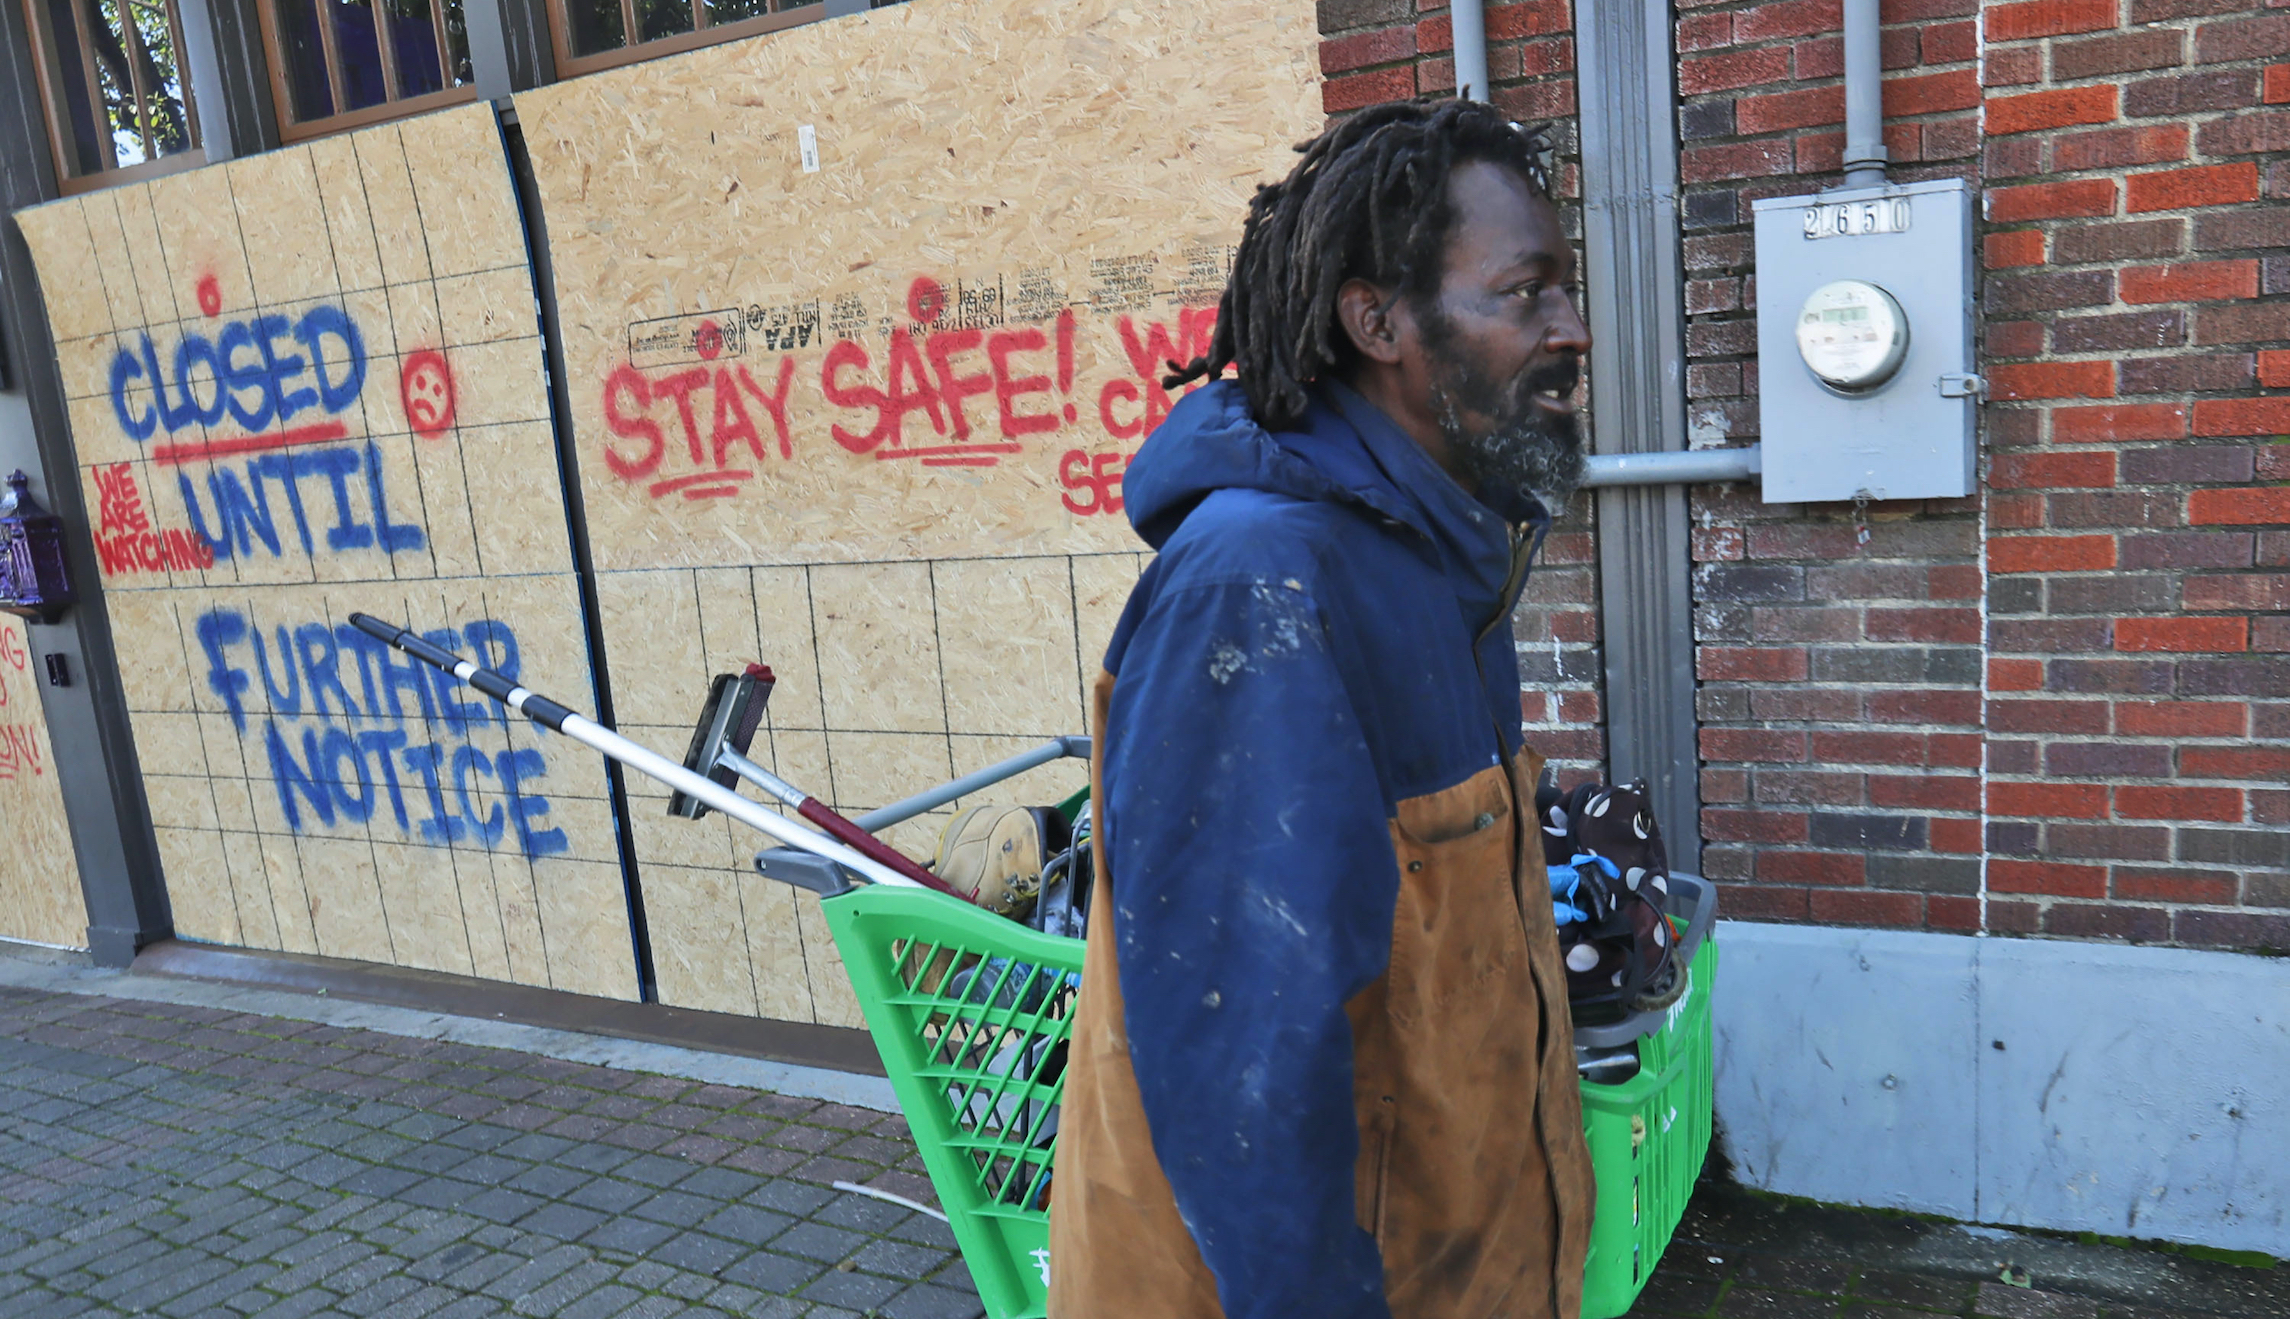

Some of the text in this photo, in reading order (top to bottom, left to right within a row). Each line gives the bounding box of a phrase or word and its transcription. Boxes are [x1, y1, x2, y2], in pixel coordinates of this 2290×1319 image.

[1804, 199, 1909, 238] 2650
[764, 324, 815, 353] APA
[108, 304, 366, 442] CLOSED
[602, 309, 1077, 481] STAY SAFE!
[1099, 378, 1197, 439] CA
[92, 462, 138, 500] WE
[178, 441, 425, 561] UNTIL
[1059, 449, 1137, 516] SE
[100, 498, 149, 536] ARE
[93, 528, 214, 577] WATCHING
[195, 608, 546, 738] FURTHER
[263, 718, 569, 863] NOTICE
